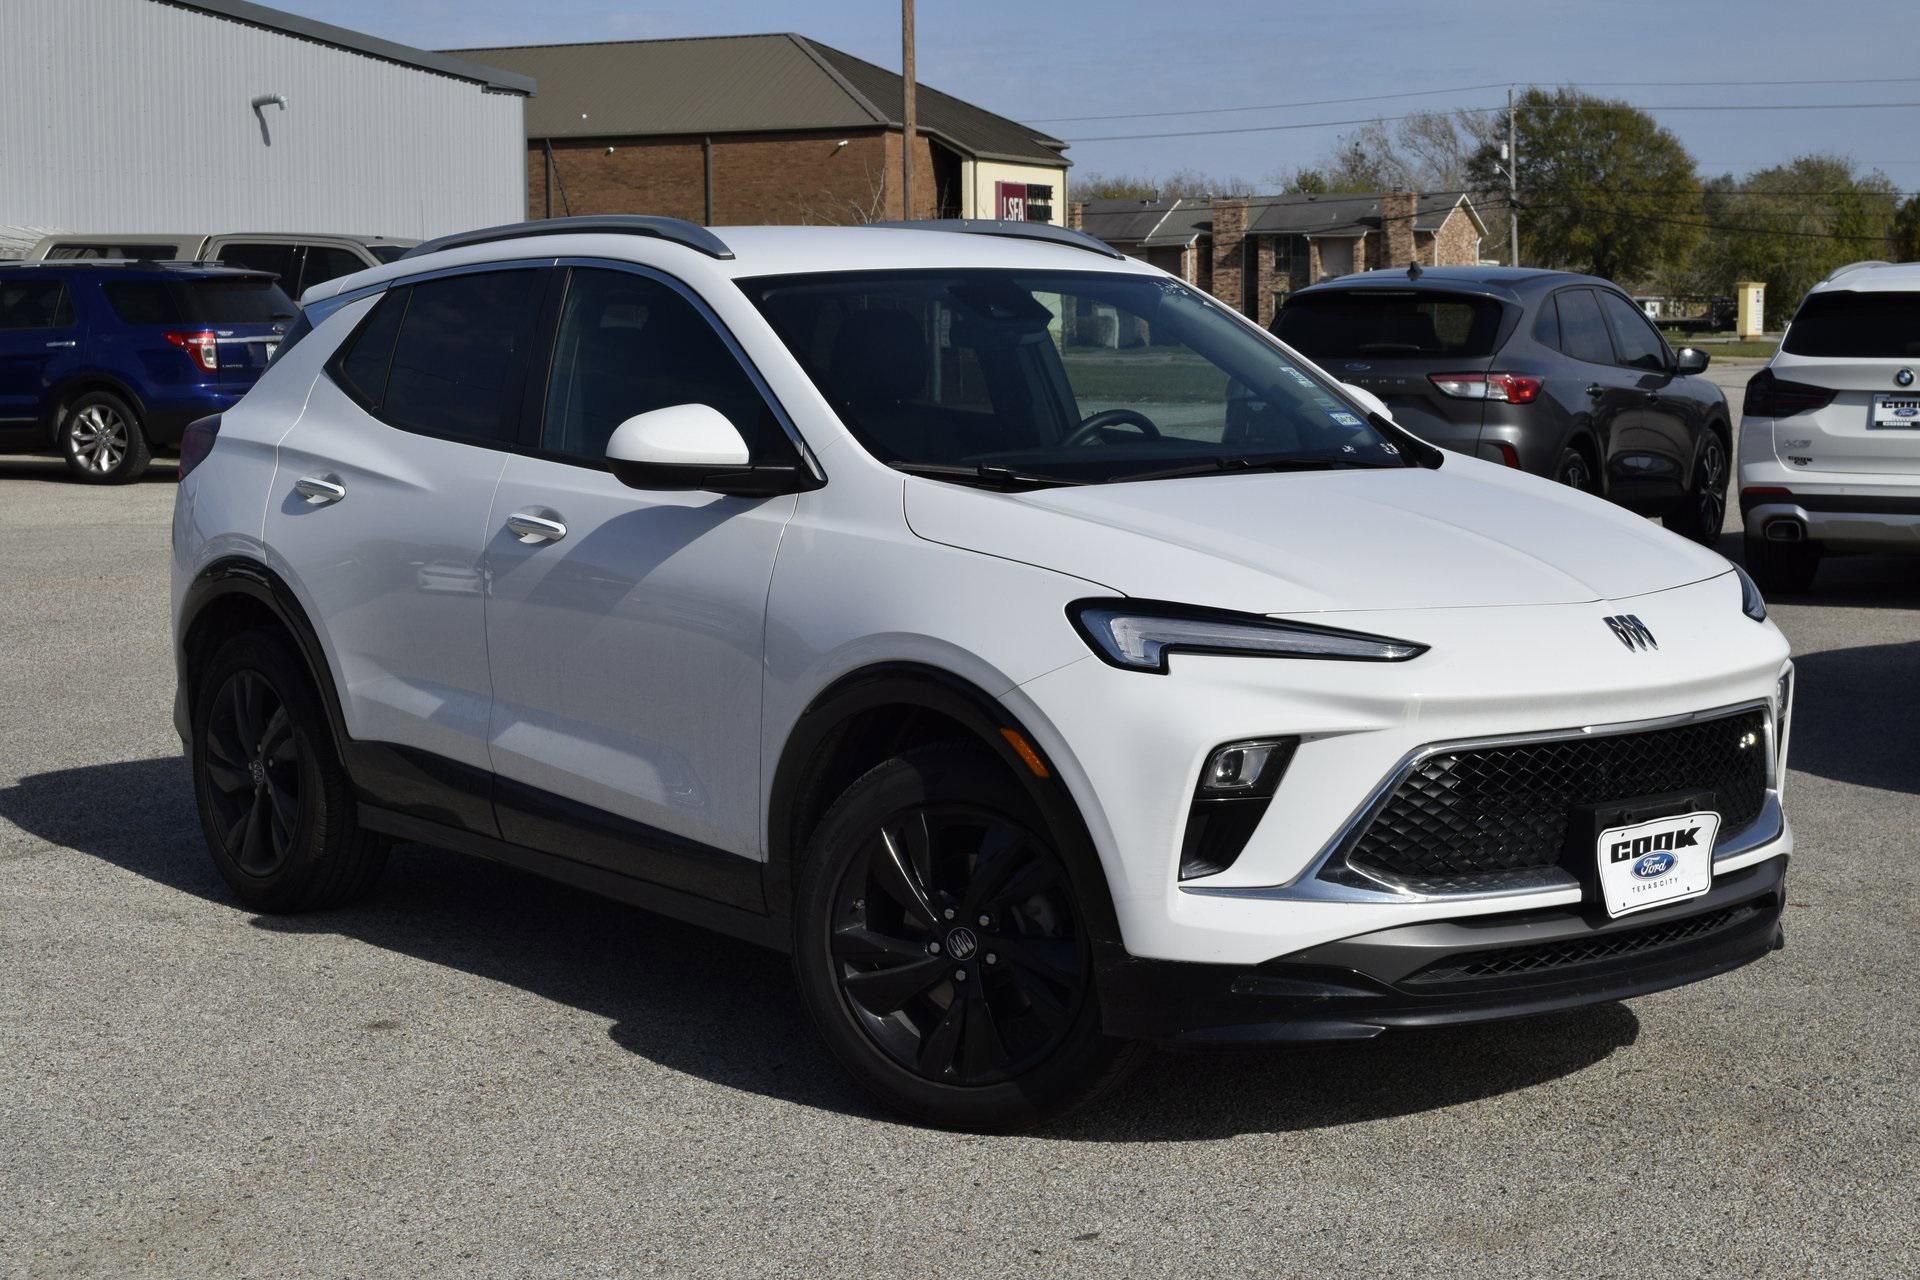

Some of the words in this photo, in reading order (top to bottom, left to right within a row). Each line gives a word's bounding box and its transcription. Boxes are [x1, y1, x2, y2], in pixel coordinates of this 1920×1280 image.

[1003, 197, 1024, 222] LSFA
[1882, 401, 1920, 409] COO
[1611, 827, 1702, 864] COOK
[1640, 856, 1667, 876] Ford
